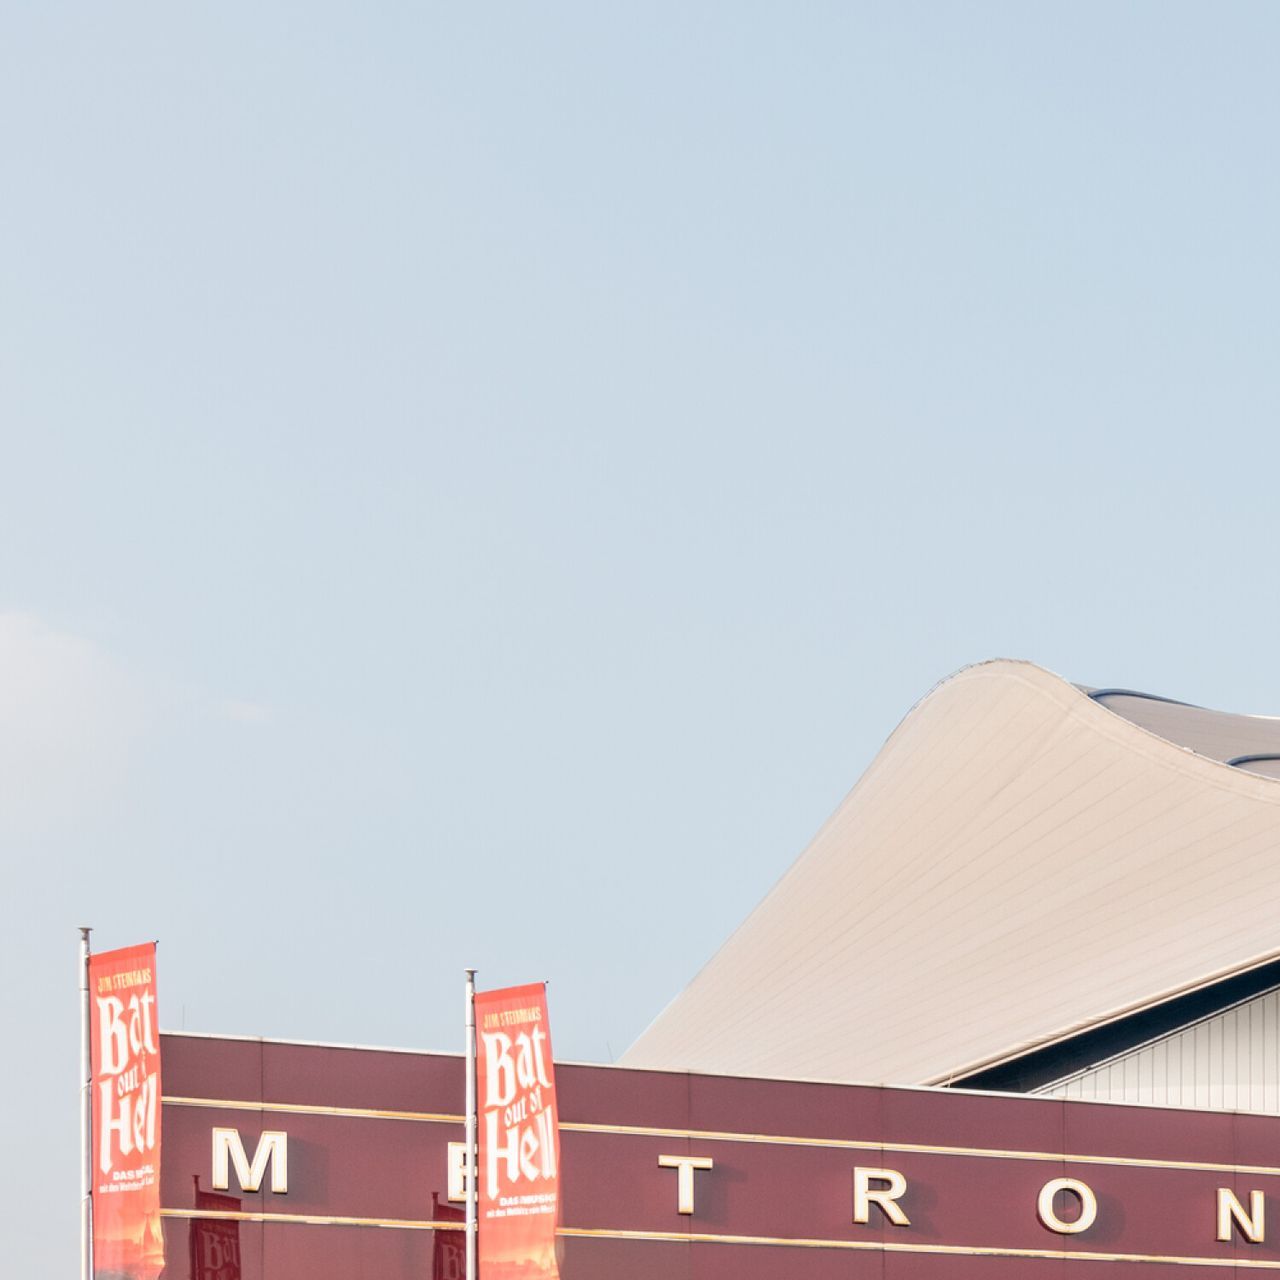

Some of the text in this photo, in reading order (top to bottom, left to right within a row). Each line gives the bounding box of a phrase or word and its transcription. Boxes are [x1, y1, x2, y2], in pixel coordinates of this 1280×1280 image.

[96, 987, 157, 1076] Bat
[481, 1024, 552, 1108] Bat
[117, 1063, 142, 1096] out
[504, 1085, 543, 1128] out of
[484, 1104, 557, 1201] Hell
